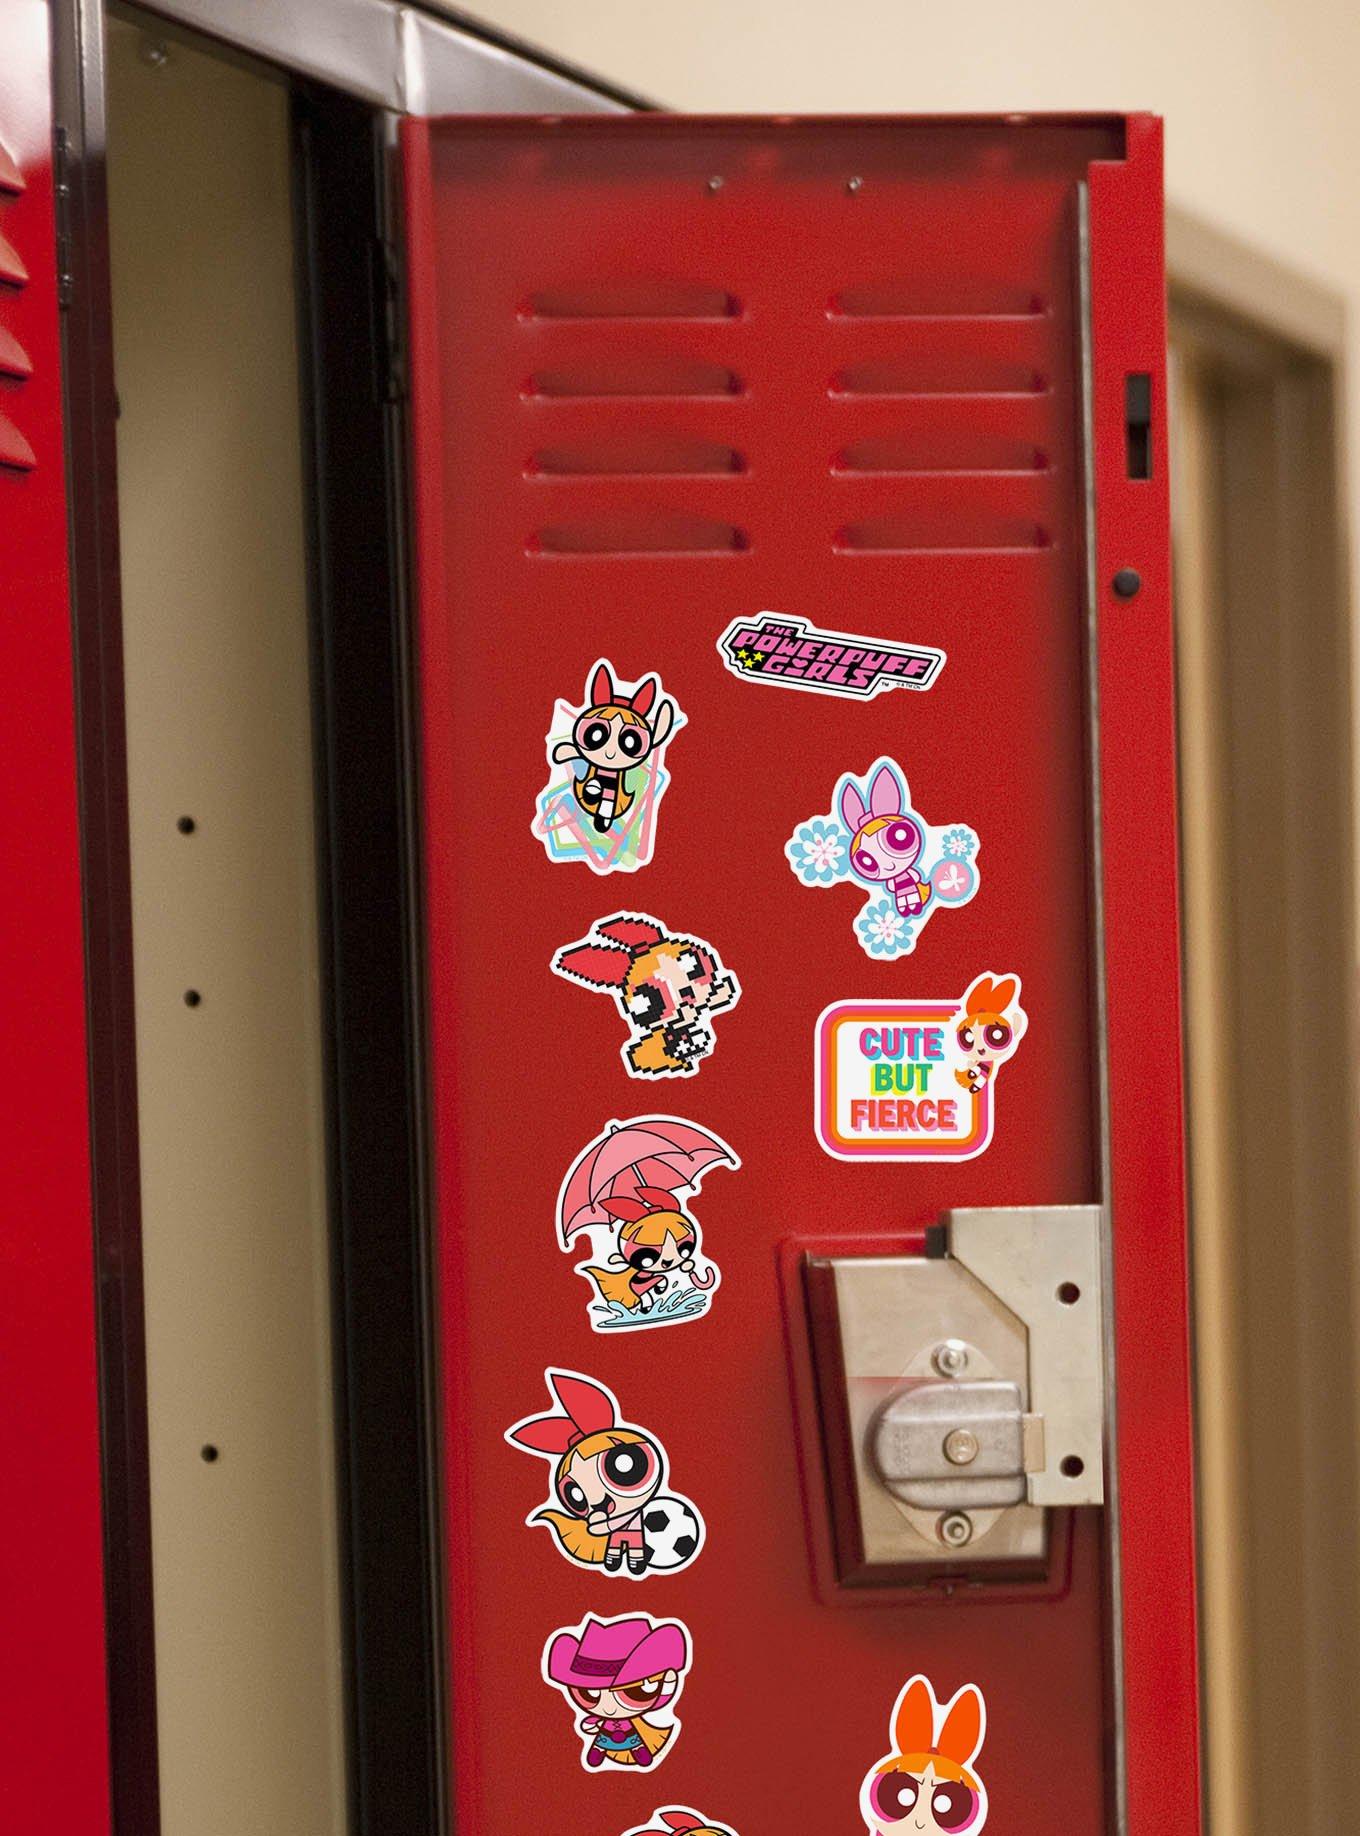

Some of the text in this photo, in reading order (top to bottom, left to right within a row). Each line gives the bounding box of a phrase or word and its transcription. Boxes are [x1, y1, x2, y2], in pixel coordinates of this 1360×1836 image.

[765, 625, 795, 636] THE
[732, 631, 929, 676] POWERPUFF
[762, 654, 875, 688] GIRLS
[859, 1027, 945, 1060] CUTE
[870, 1063, 933, 1096] BUT
[851, 1099, 958, 1132] FIERCE
